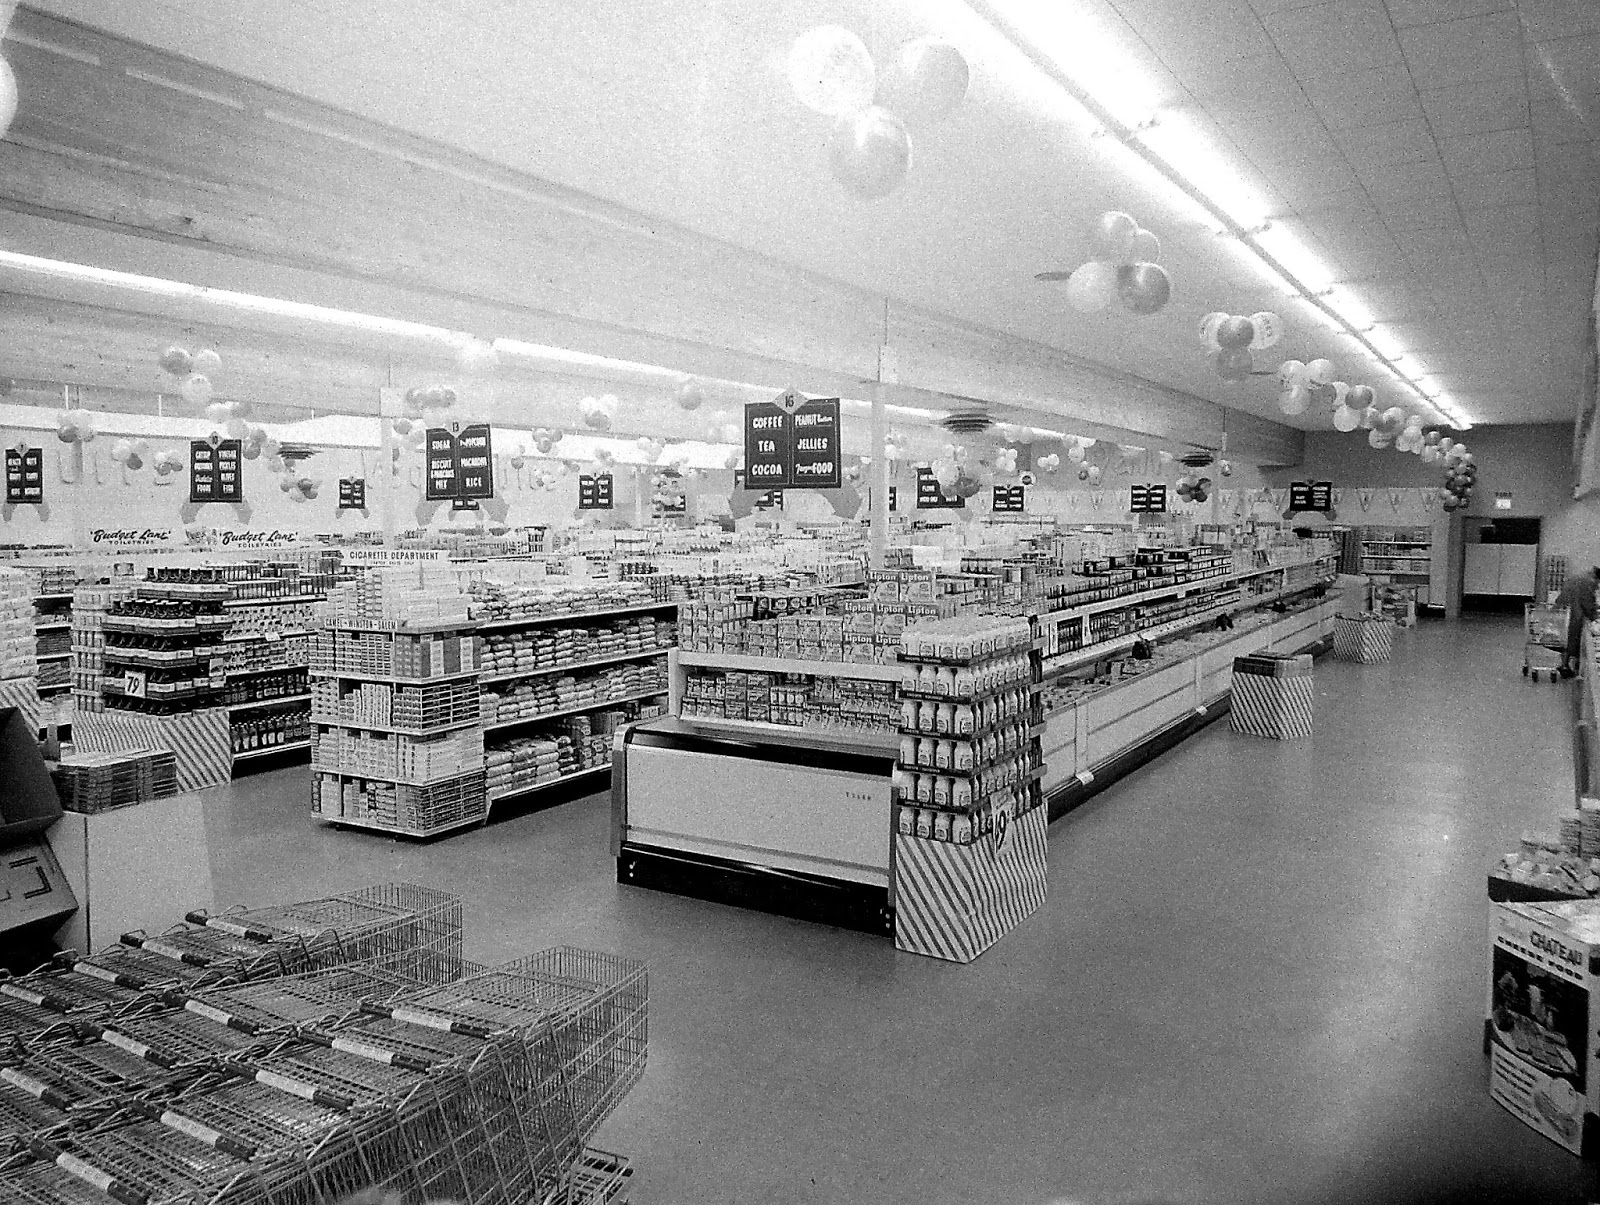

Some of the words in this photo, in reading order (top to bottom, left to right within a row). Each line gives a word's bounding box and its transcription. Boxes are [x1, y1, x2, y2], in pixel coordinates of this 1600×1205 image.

[753, 416, 783, 428] COFFEE
[795, 414, 817, 426] PEANUT
[432, 440, 450, 450] SUGAR
[758, 440, 775, 452] TEA
[797, 438, 828, 450] JELLIES
[219, 461, 236, 471] PICKLES
[431, 459, 452, 469] BISCUIT
[813, 462, 833, 474] FOOD
[752, 464, 782, 476] COCOA
[466, 477, 482, 487] RICE
[350, 551, 388, 559] CIGARETTE
[391, 552, 439, 560] DEPARTMENT
[870, 572, 897, 582] Lipton
[901, 572, 929, 583] Lipton
[845, 602, 872, 613] Lipton
[877, 603, 904, 615] Lipton
[908, 605, 936, 616] Lipton
[845, 633, 872, 644] Lipton
[803, 702, 821, 711] Lipton
[822, 704, 840, 713] Lipton
[1529, 930, 1582, 966] CHATEAU
[1497, 935, 1544, 962] CHEESE
[1547, 960, 1583, 980] FOOD
